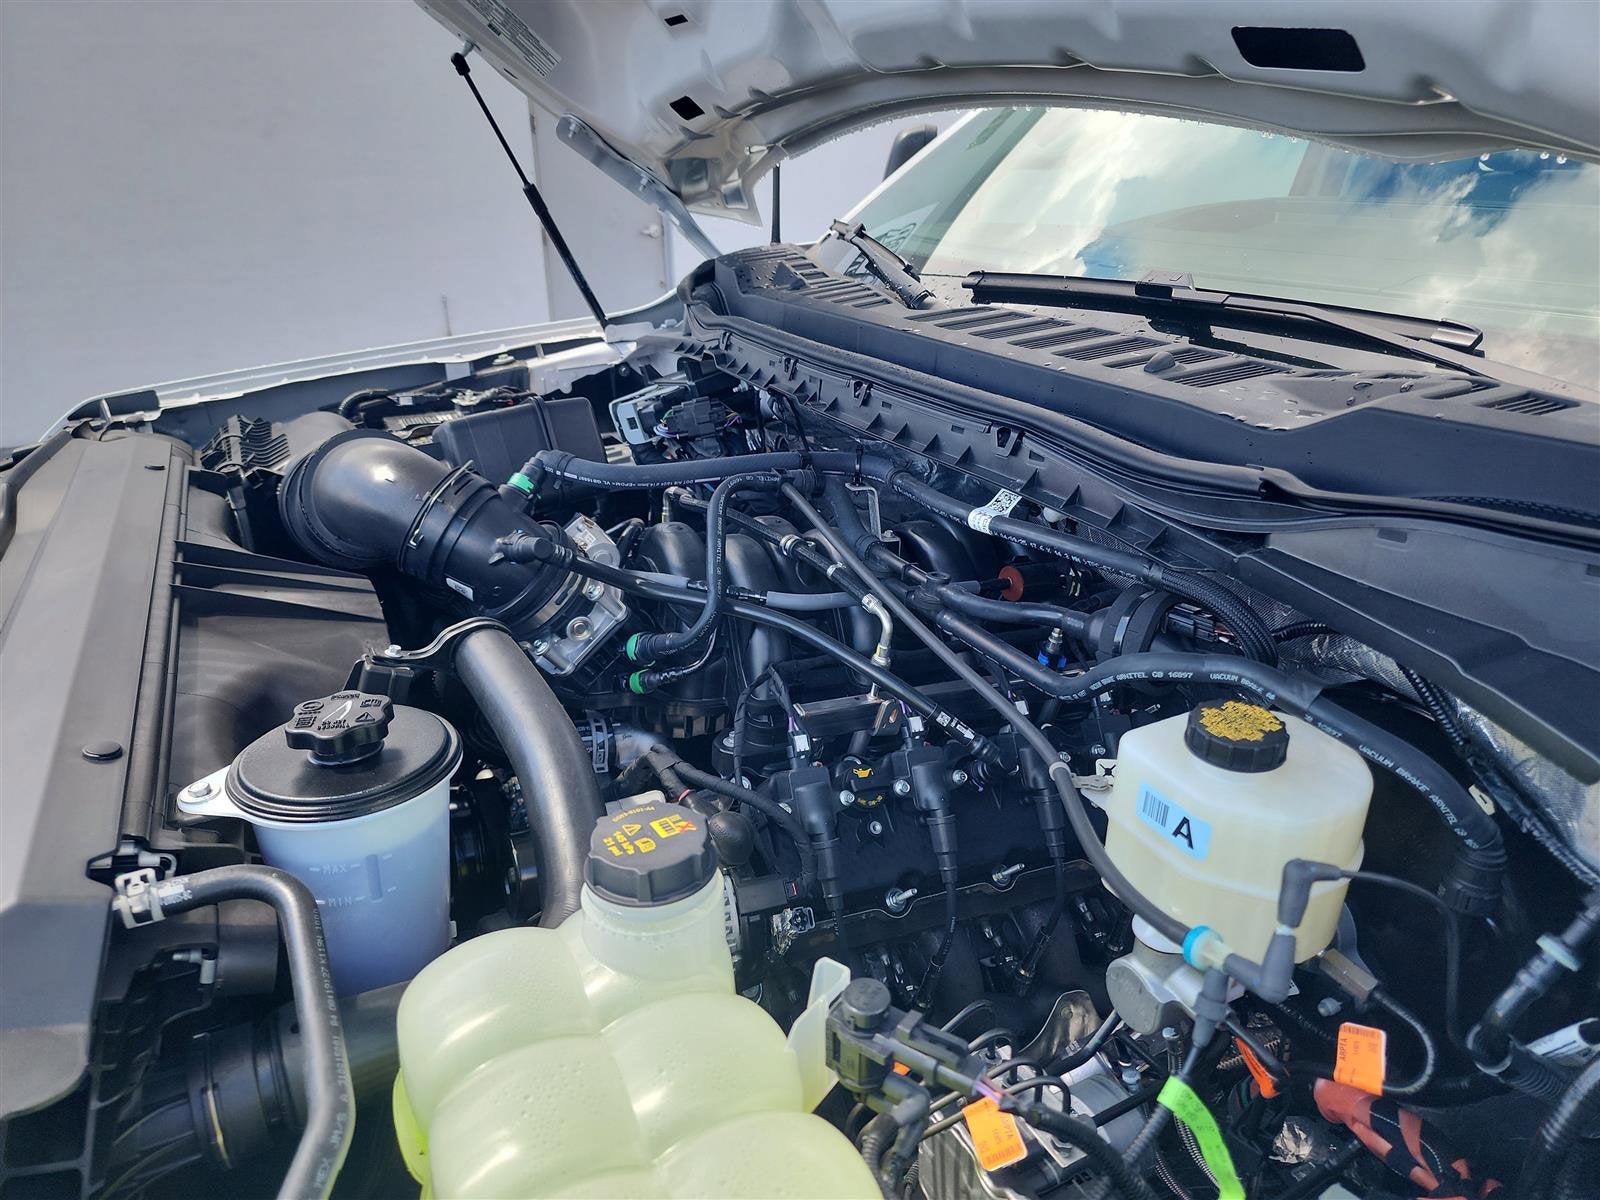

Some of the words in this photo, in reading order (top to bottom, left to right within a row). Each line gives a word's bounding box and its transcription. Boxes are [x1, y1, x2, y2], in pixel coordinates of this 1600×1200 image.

[1209, 673, 1238, 683] VACUUM
[1358, 744, 1395, 769] VACUUM
[1395, 767, 1431, 793] BRAKE
[1429, 792, 1458, 826] ARNITEL
[1172, 816, 1194, 850] A
[322, 863, 348, 874] MAX
[328, 896, 352, 907] MIN
